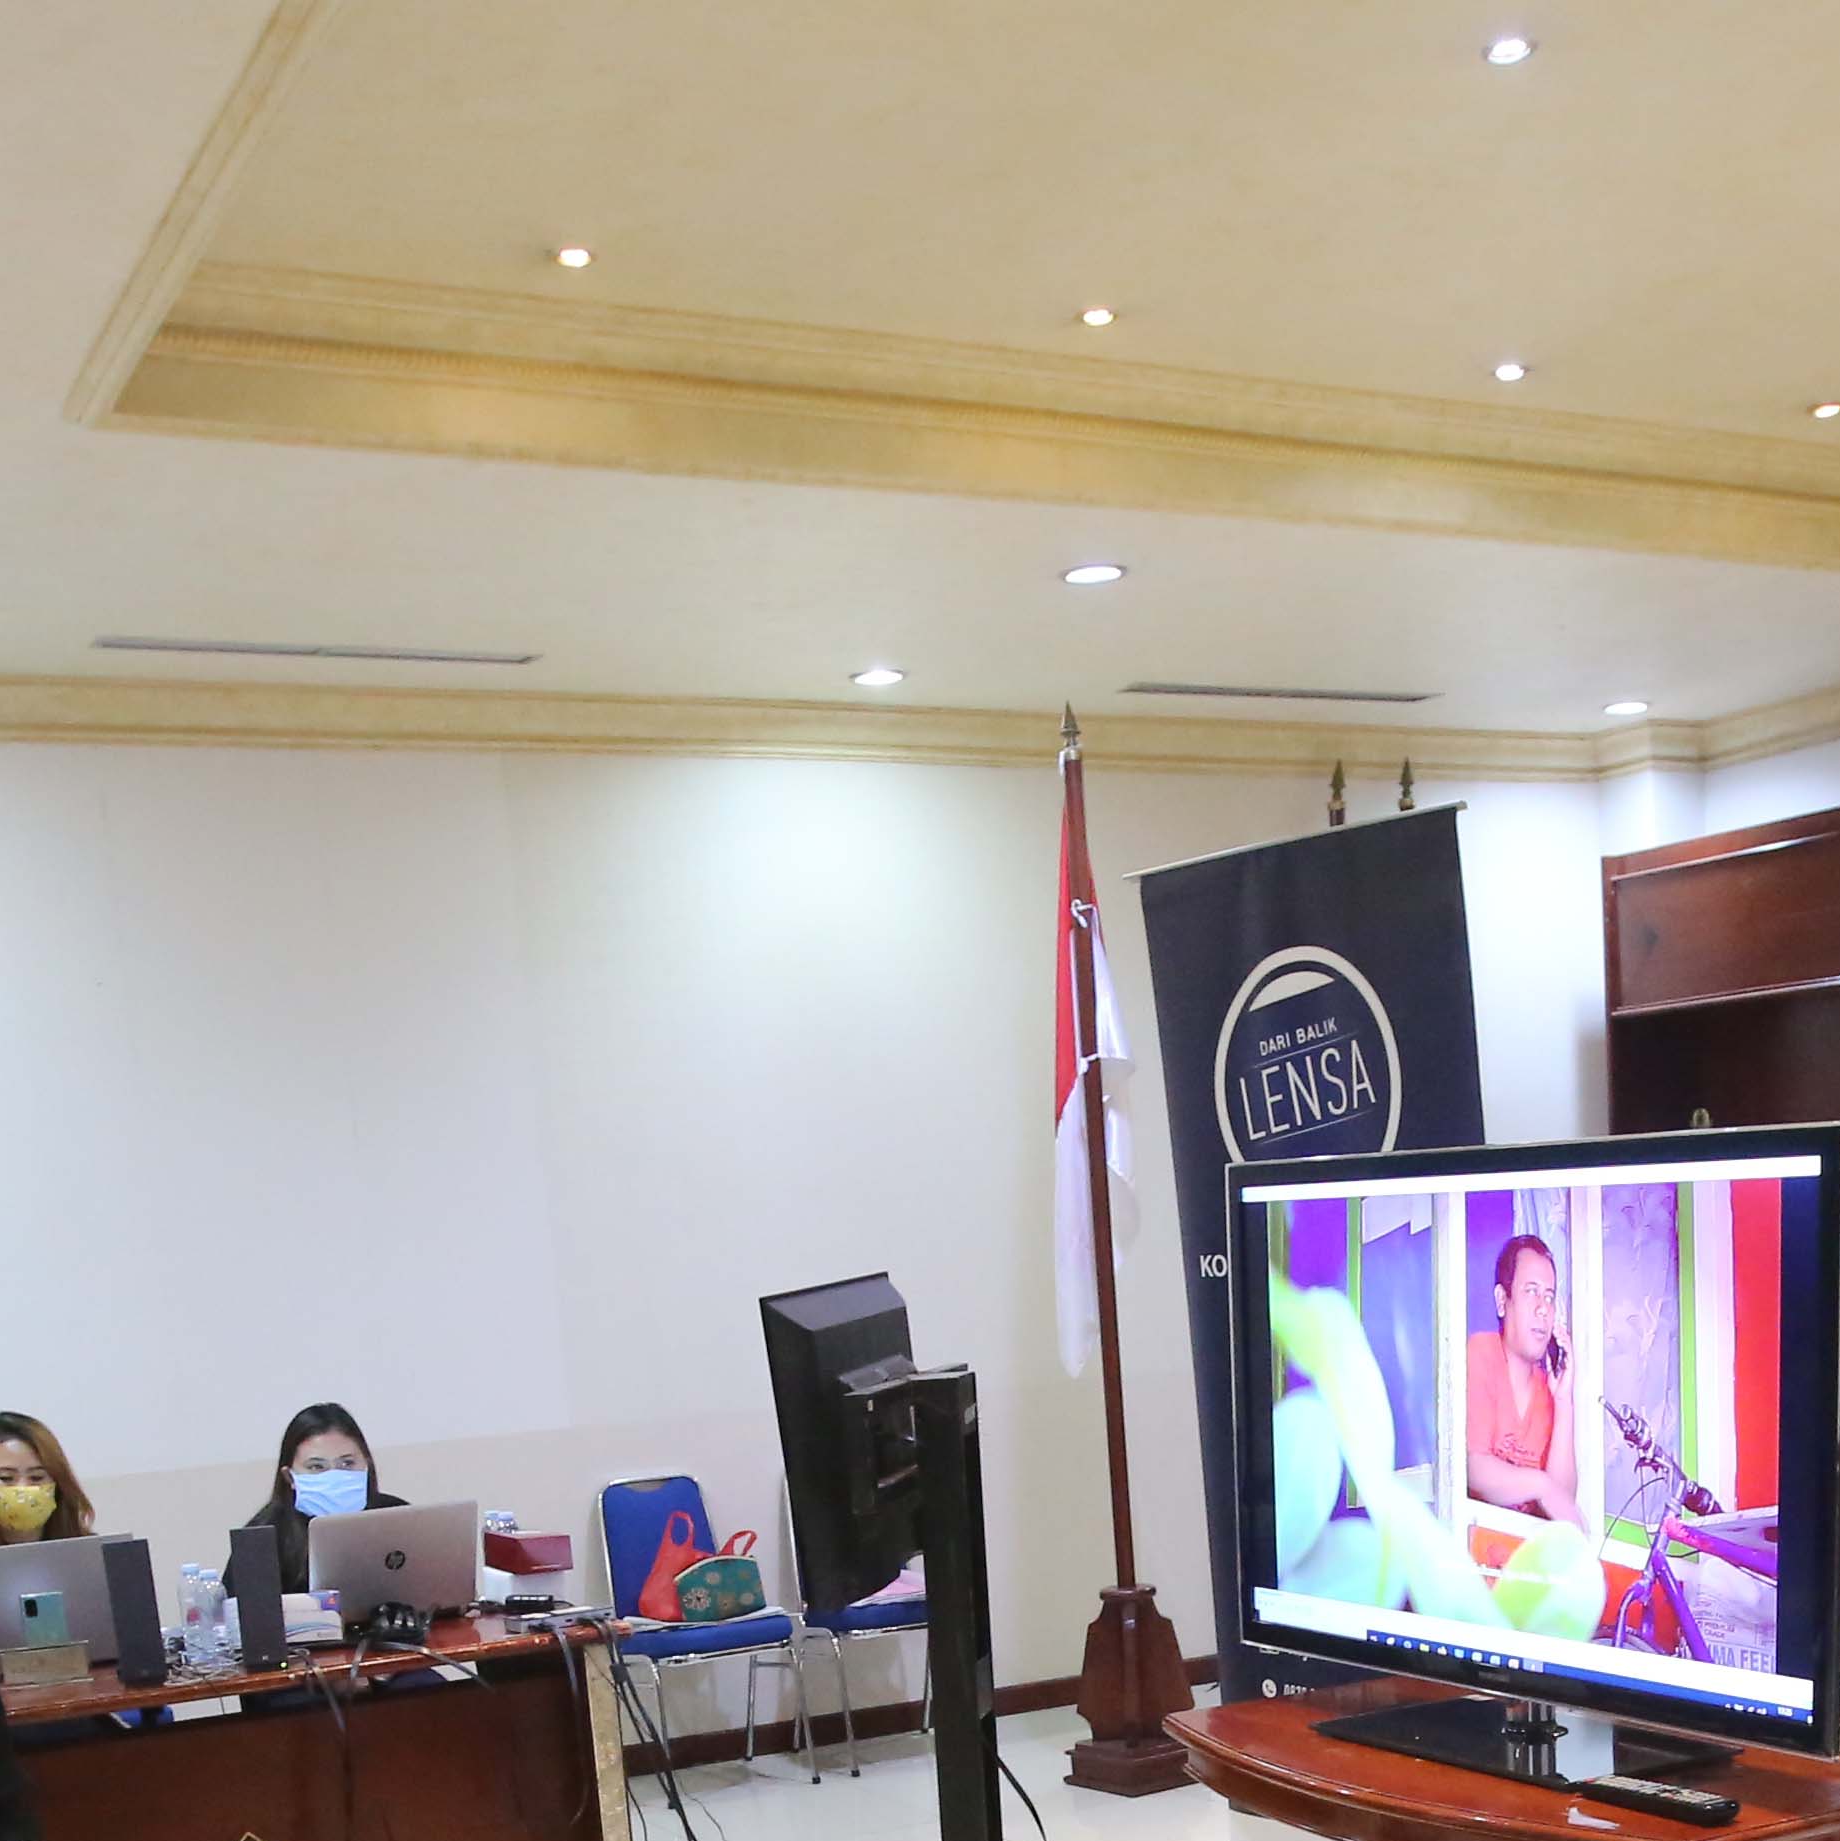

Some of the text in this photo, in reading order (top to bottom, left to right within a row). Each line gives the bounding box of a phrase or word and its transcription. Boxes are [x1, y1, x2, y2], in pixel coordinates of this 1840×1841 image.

[1259, 1016, 1338, 1057] DARI BALIK
[1239, 1039, 1376, 1141] LENSA
